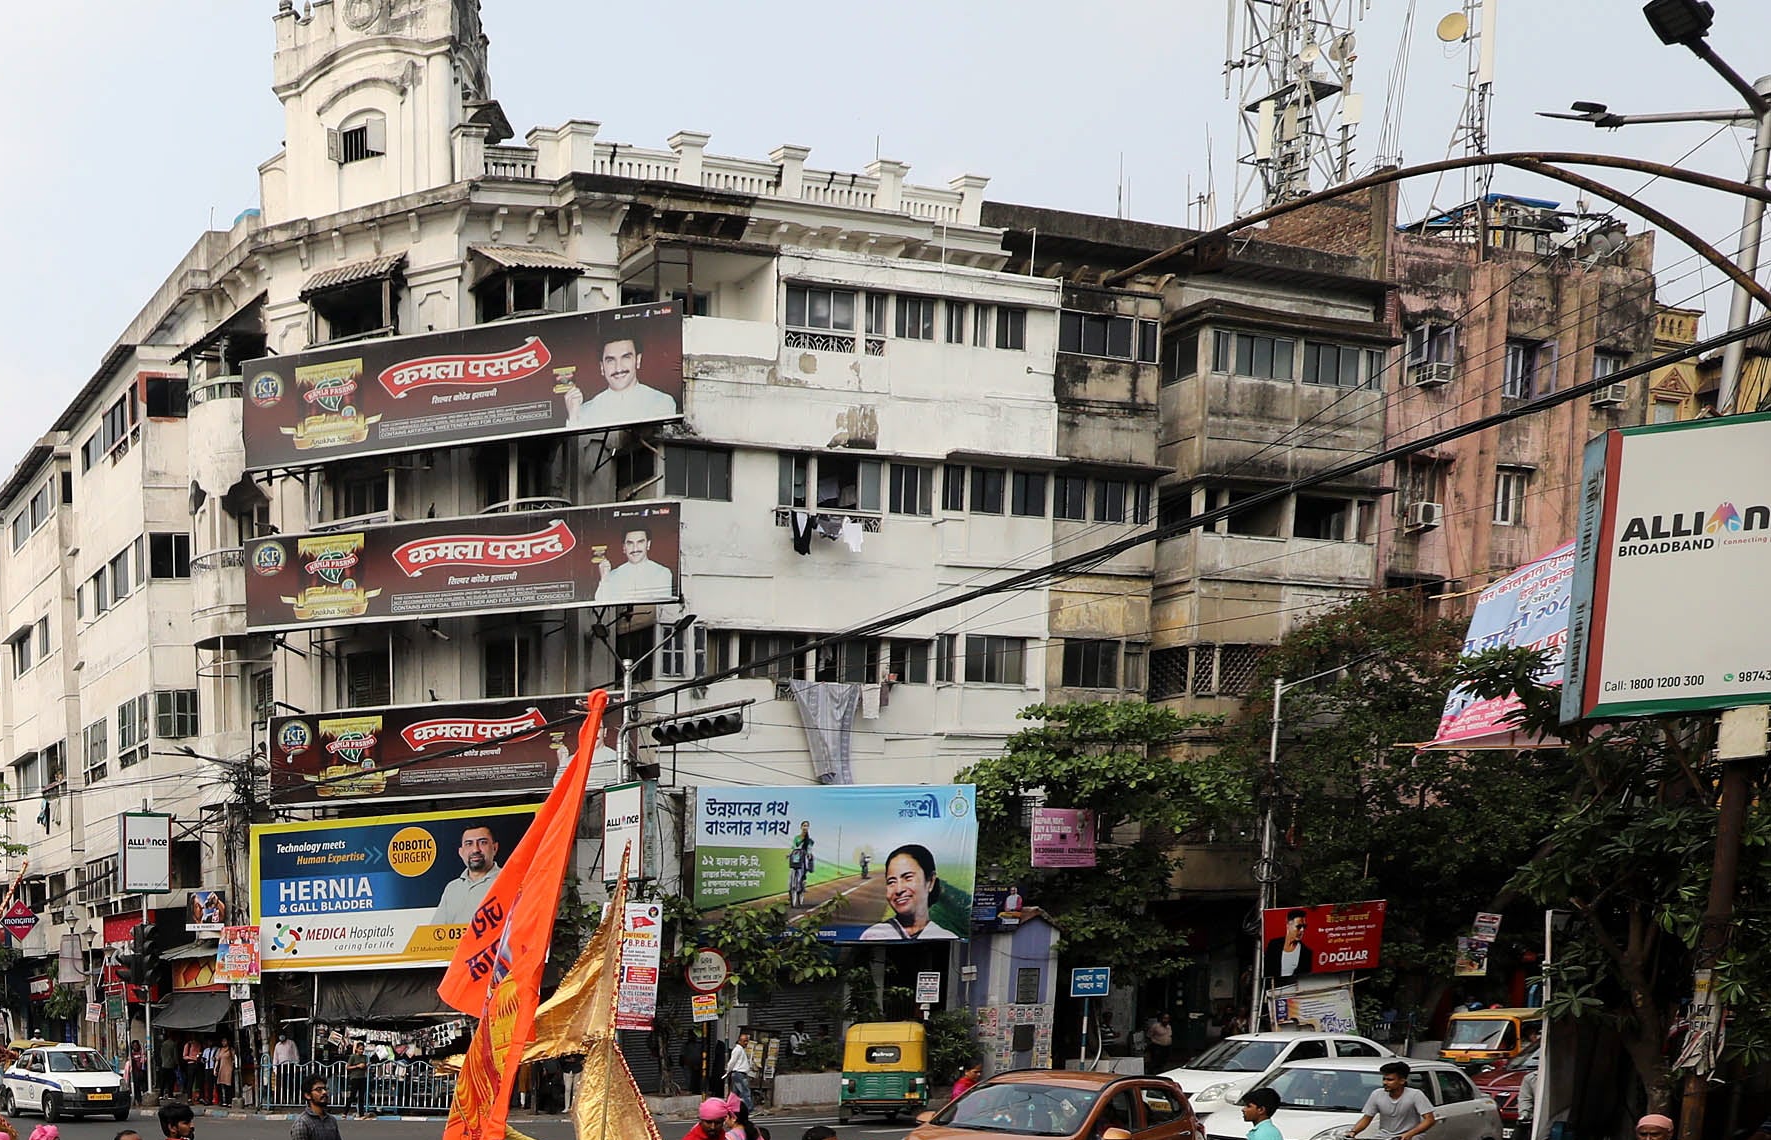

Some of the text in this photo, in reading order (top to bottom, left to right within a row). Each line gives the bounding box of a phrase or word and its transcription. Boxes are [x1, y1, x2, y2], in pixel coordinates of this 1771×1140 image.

[393, 350, 539, 385] कमला पसन्द
[408, 534, 563, 564] कमला पसन्द
[1618, 538, 1714, 557] BROADBAND
[261, 550, 278, 562] KP
[309, 557, 356, 571] KAMLA PASAND
[1605, 681, 1627, 692] Call:
[1630, 679, 1653, 690] 1800
[1657, 677, 1680, 688] 1200
[1683, 675, 1704, 686] 300
[286, 731, 304, 741] KP
[413, 723, 475, 740] कमला
[705, 798, 789, 818] উন্নয়নের পথ
[705, 820, 790, 836] বাংলার শপথ
[276, 840, 346, 854] Technology meets
[392, 838, 432, 851] ROBOTIC
[297, 852, 365, 865] Human Expertise
[392, 851, 432, 864] SURGERY
[279, 877, 373, 902] HERNIA
[279, 899, 373, 913] & GALL BLADDER
[305, 924, 394, 941] MEDICA Hospitals
[334, 941, 394, 952] caring for life
[1329, 950, 1368, 962] DOLLAR
